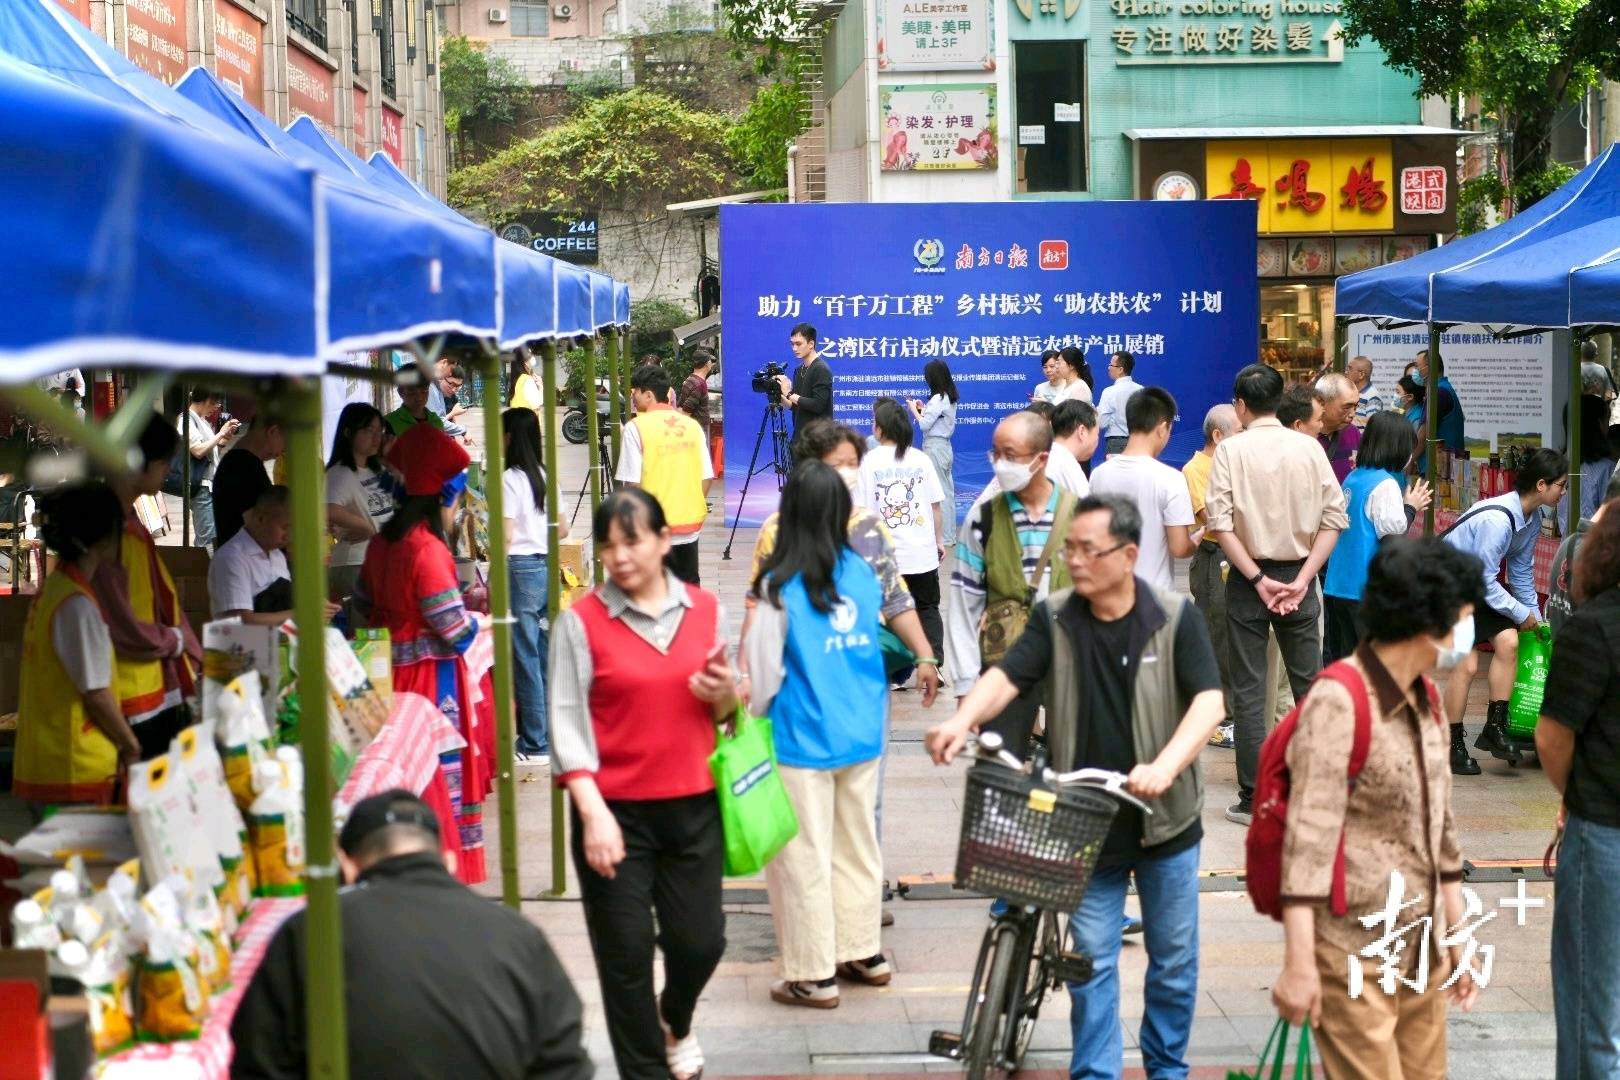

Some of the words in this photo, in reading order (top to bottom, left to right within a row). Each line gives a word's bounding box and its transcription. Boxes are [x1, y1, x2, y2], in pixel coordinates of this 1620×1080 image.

[1180, 0, 1273, 19] coloring
[568, 221, 596, 234] 244
[533, 237, 597, 251] COFFEE
